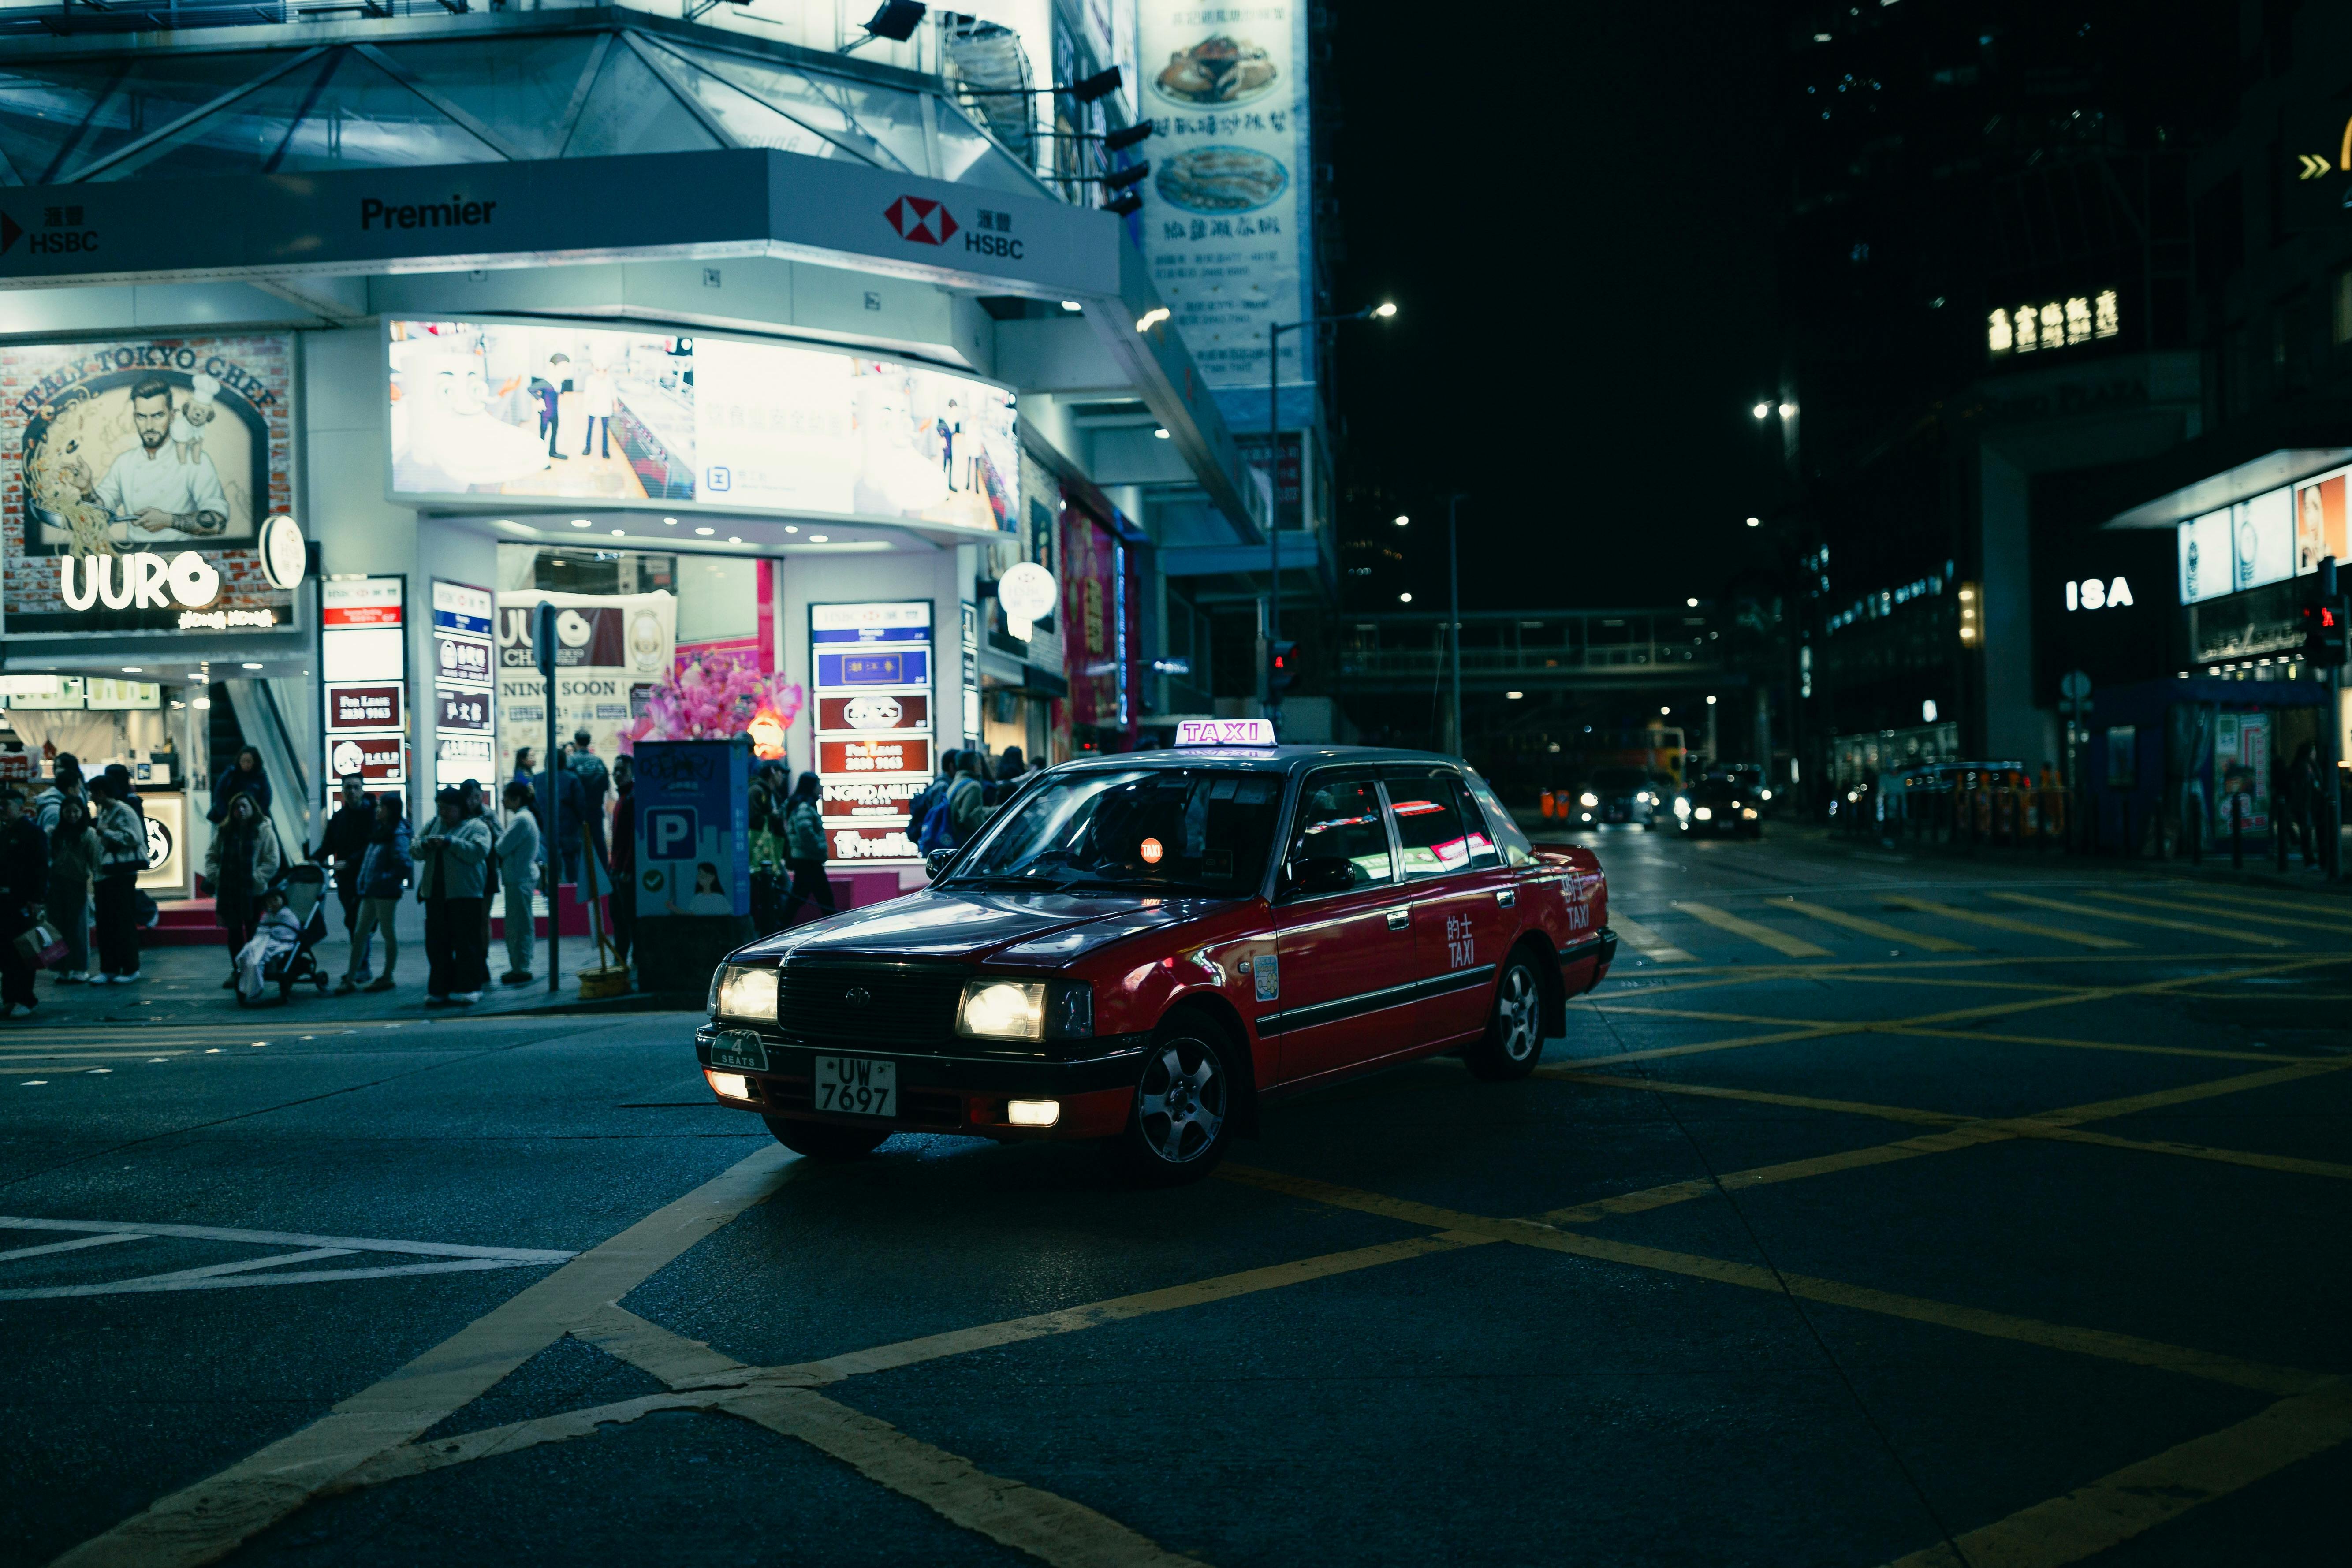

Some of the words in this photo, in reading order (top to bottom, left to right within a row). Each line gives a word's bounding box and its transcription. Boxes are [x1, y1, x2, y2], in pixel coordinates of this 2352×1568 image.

[362, 194, 496, 230] Premier
[30, 231, 99, 254] HSBC
[965, 231, 1023, 260] HSBC
[16, 360, 86, 418] ITALY
[95, 346, 196, 372] TOKYO
[205, 356, 277, 406] CHEF
[61, 550, 220, 611] UURO
[2065, 576, 2134, 611] ISA
[562, 680, 615, 696] SOON
[1183, 723, 1258, 741] TAXI
[823, 784, 877, 801] INGRID
[656, 814, 688, 854] P
[1141, 844, 1161, 857] TAXI
[1561, 872, 1588, 904] 的士
[1446, 912, 1472, 942] 的士
[1566, 903, 1589, 931] TAXI
[1448, 938, 1474, 968] TAXI
[728, 1030, 753, 1039] TAXI
[731, 1039, 742, 1055] 4
[721, 1054, 755, 1067] SEATS
[839, 1058, 872, 1087] UW
[821, 1083, 889, 1114] 7697
